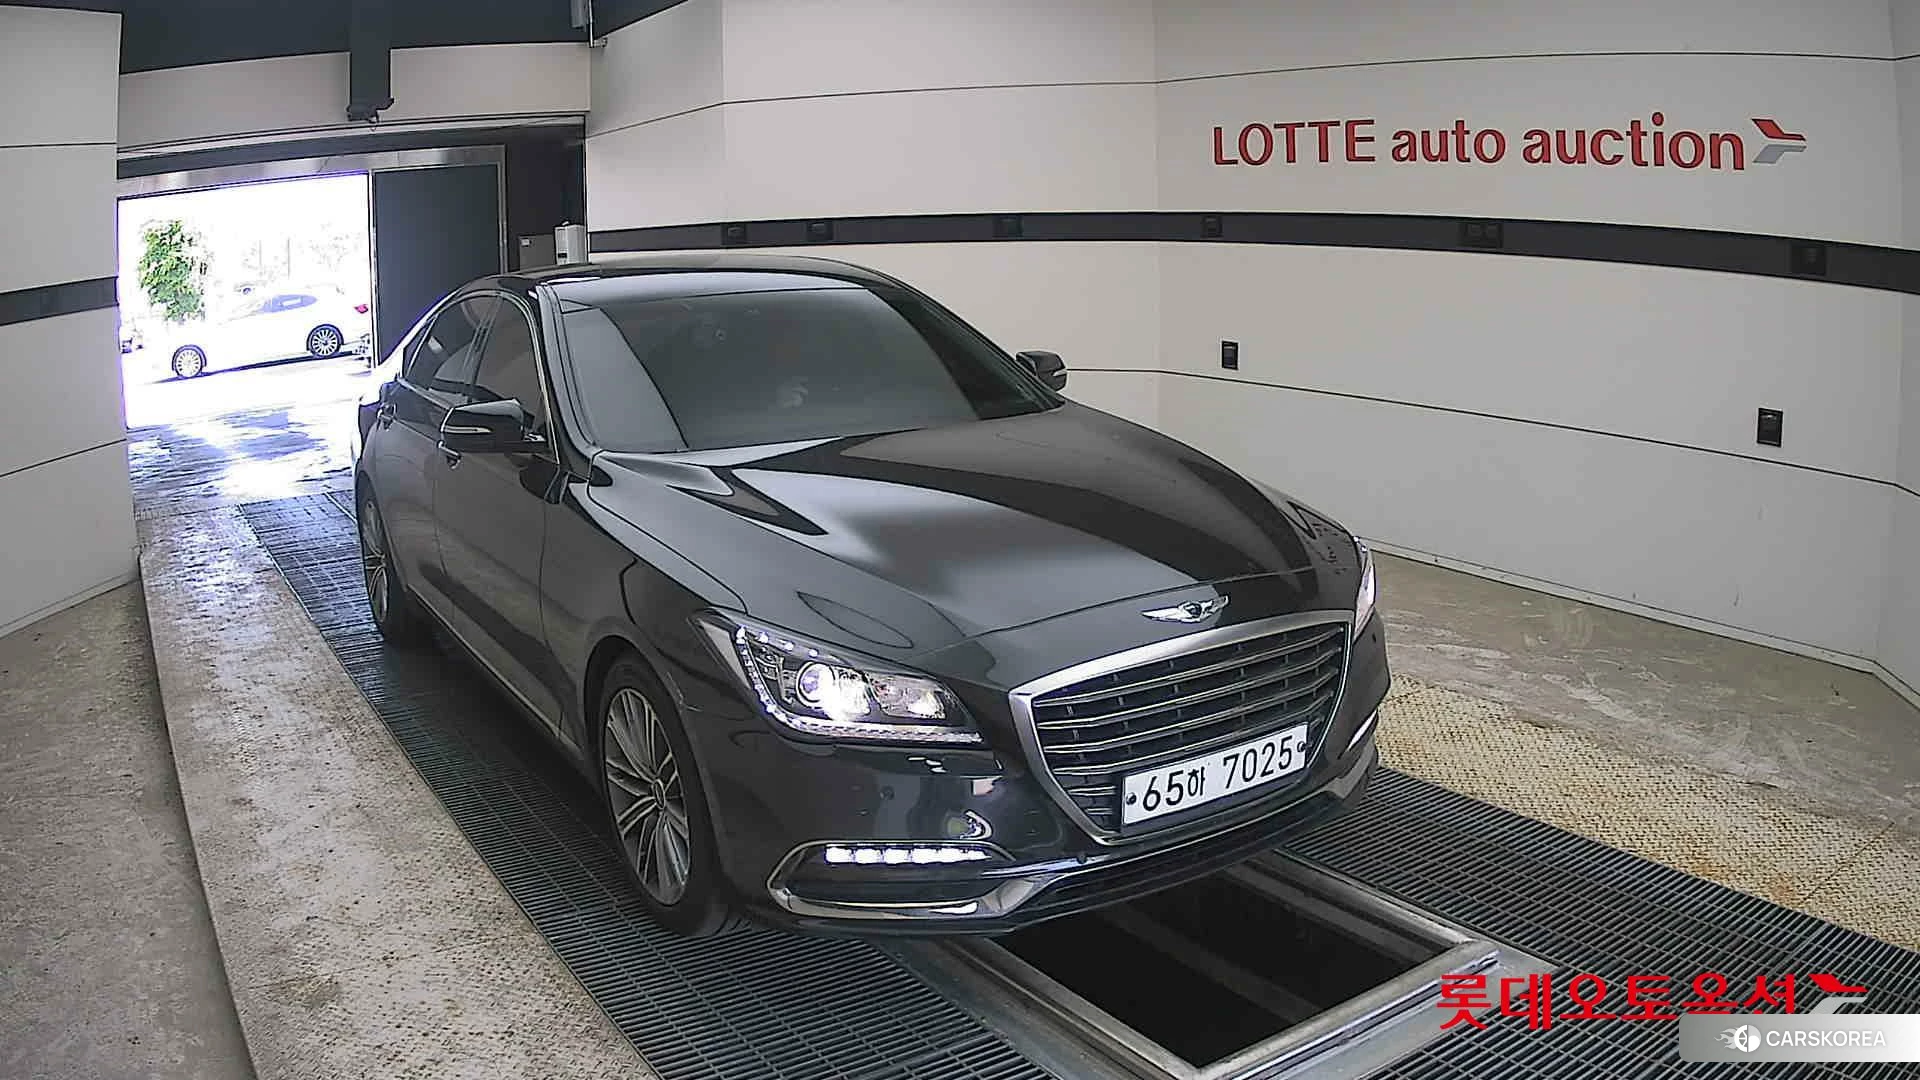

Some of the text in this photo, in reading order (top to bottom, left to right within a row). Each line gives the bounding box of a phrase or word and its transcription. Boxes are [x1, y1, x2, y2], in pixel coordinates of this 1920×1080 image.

[1213, 112, 1745, 171] LOTTE auto auction
[1142, 735, 1294, 811] 65하 7025
